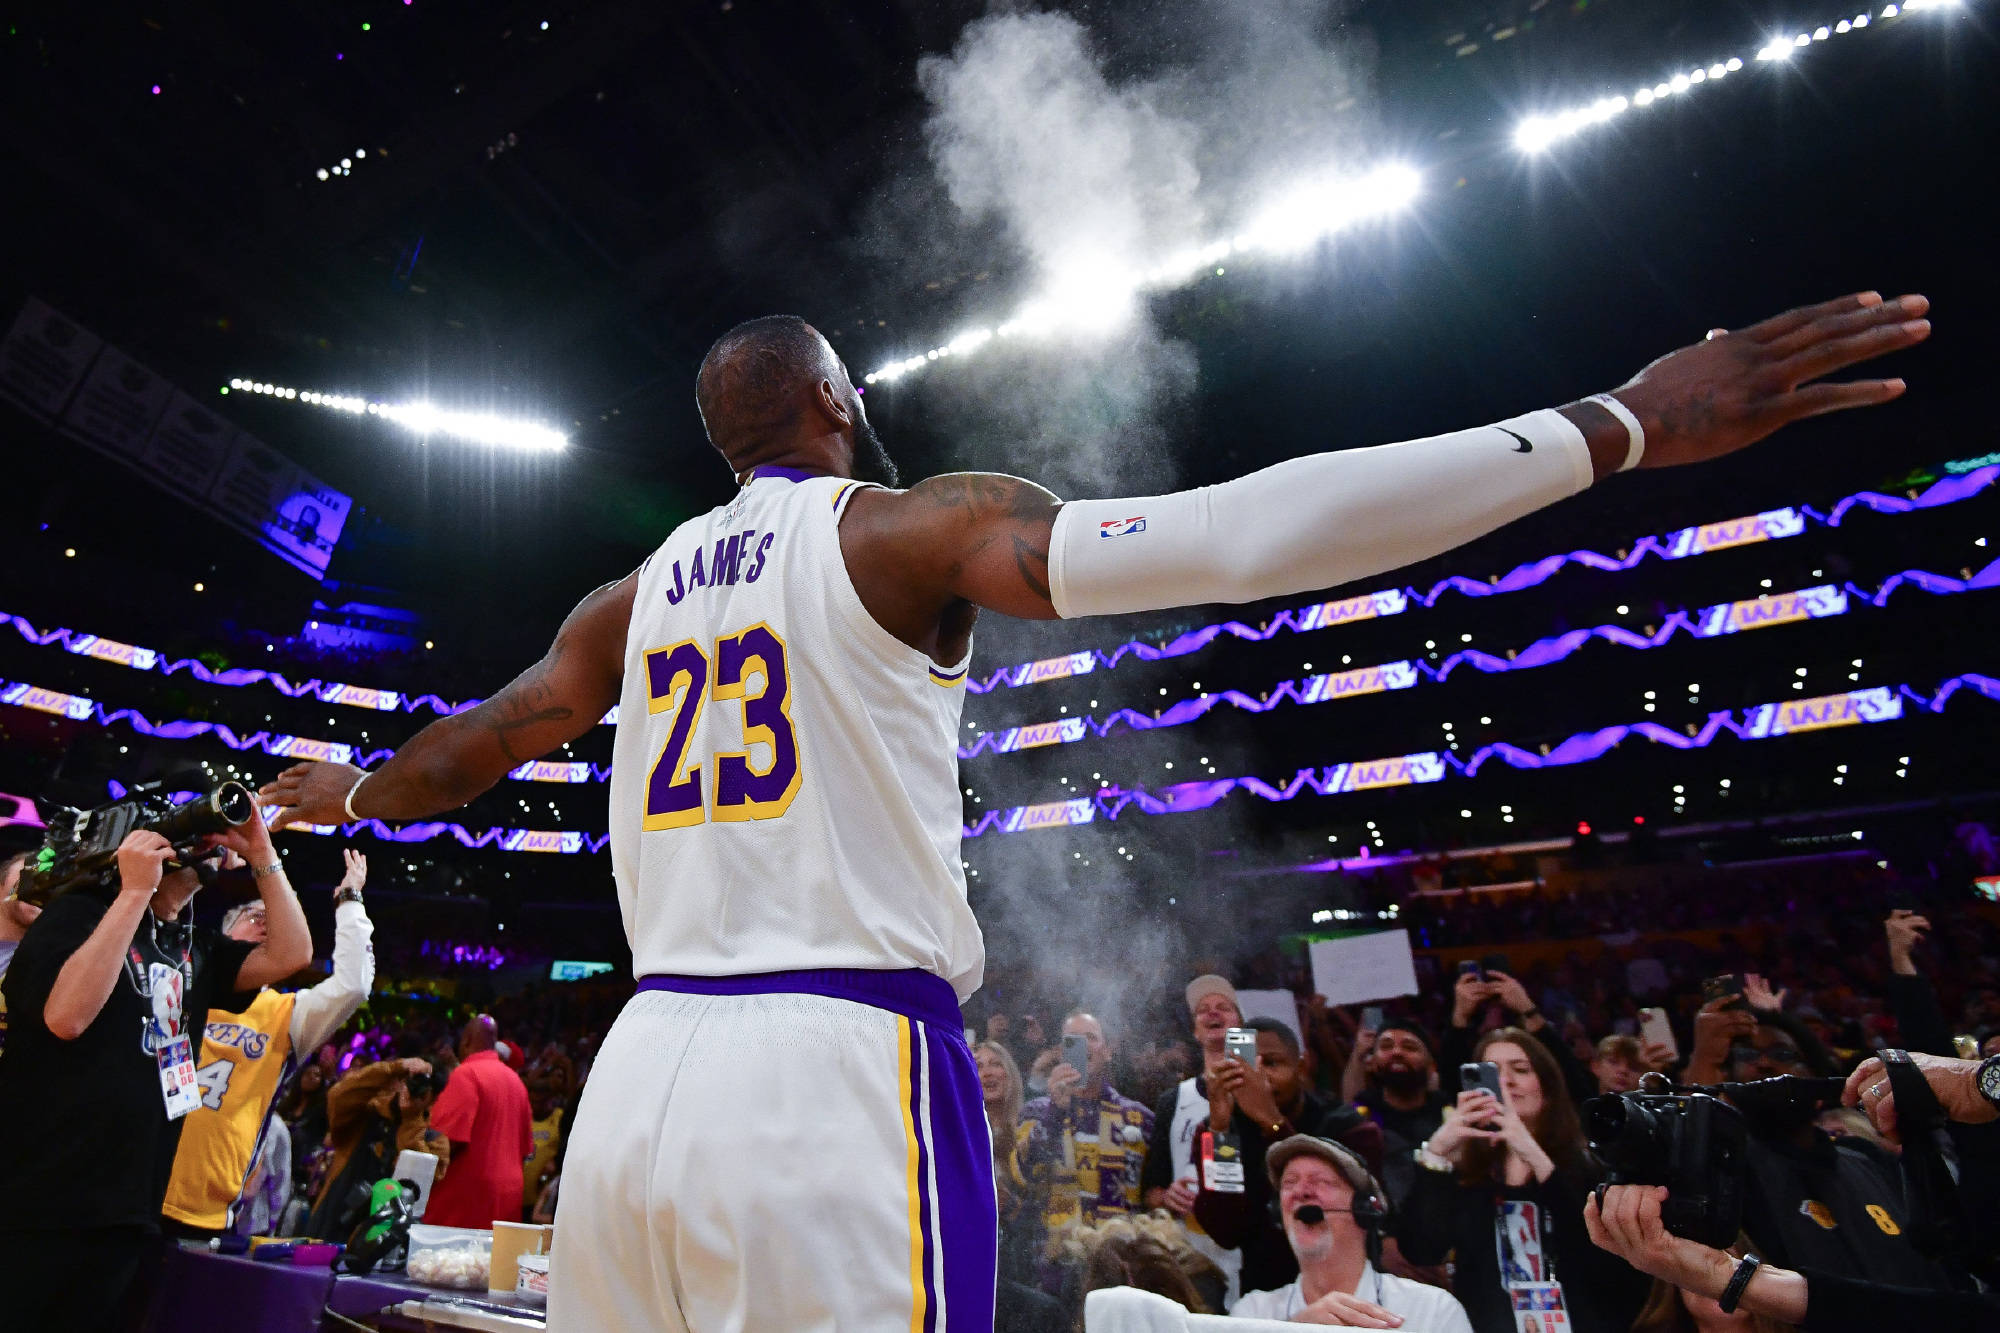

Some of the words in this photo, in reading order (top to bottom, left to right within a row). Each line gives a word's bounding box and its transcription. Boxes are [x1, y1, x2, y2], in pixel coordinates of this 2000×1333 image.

[666, 529, 775, 606] JAMES
[642, 620, 803, 832] 23
[205, 1023, 269, 1060] KERS
[1865, 1204, 1902, 1235] 8
